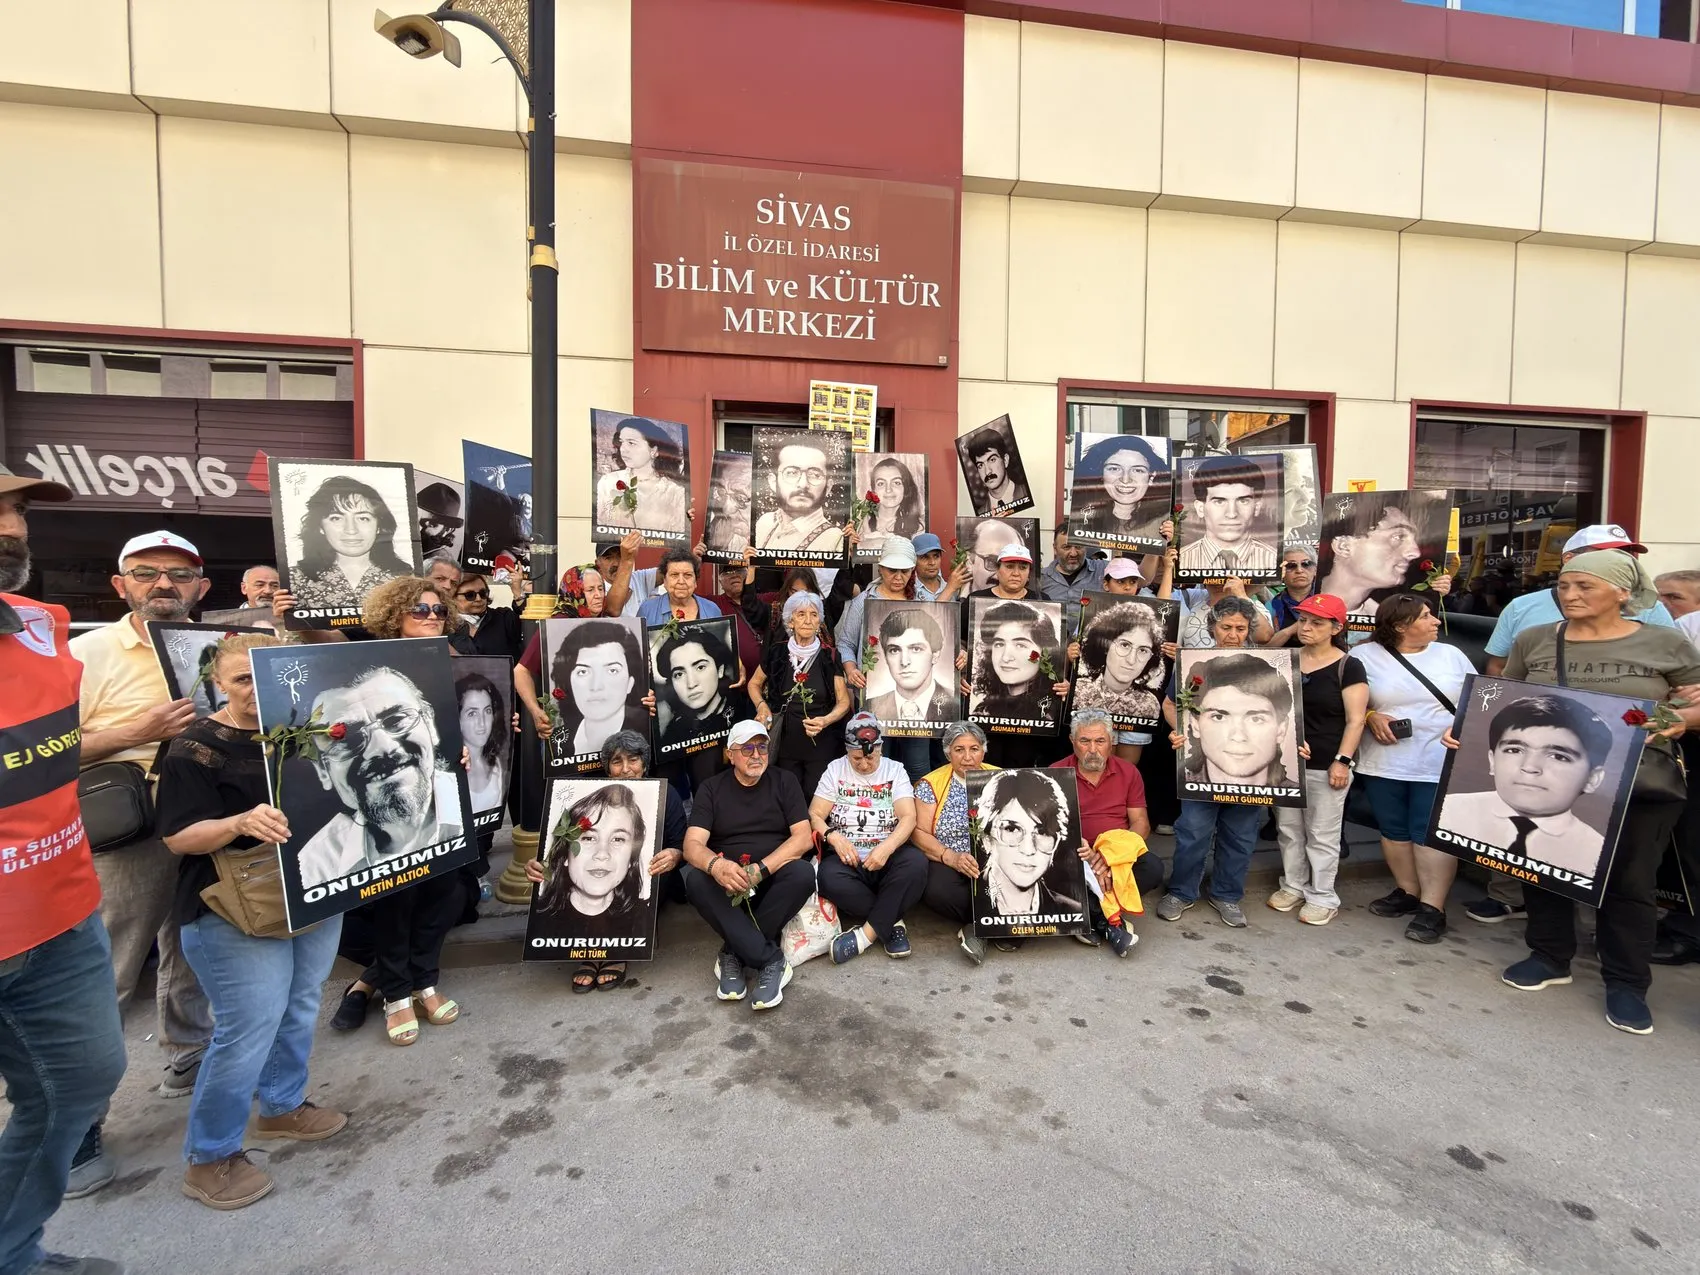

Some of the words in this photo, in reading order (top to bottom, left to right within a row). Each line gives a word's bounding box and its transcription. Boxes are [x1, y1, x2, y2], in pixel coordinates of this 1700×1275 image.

[756, 192, 851, 231] SİVAS
[724, 231, 742, 251] İL
[747, 234, 797, 257] ÖZEL
[803, 238, 880, 262] İDARESİ
[653, 257, 755, 295] BİLİM
[764, 278, 799, 298] ve
[807, 269, 941, 307] KÜLTÜR
[723, 307, 876, 340] MERKEZİ
[979, 496, 1030, 518] ONRUMUZ
[1074, 529, 1163, 547] ONURUMUZ
[707, 550, 744, 560] ONUR
[756, 549, 844, 560] ONURUMUZ
[775, 559, 796, 567] HASRET
[1178, 569, 1277, 577] ONURUMUZ
[293, 607, 363, 619] ONUR
[330, 617, 359, 626] HURİYE
[877, 719, 953, 729] NURUMUZ
[967, 715, 1055, 728] ONURUMUZ
[991, 725, 1016, 733] ASUMAN
[661, 729, 730, 753] ONURUMU
[550, 752, 602, 767] ONUR
[1185, 782, 1302, 797] ONURUMUZ
[1213, 794, 1239, 803] MURAT
[1240, 795, 1273, 805] GÜNDÜZ
[26, 821, 77, 853] SULTAN
[3, 844, 63, 874] ÜLTÜR
[1435, 829, 1593, 891] ONURUMUZ
[303, 836, 467, 904] ONURUMUZ
[1475, 854, 1510, 874] KORAY
[1511, 863, 1539, 884] KAYA
[359, 878, 394, 900] METİN
[396, 864, 431, 886] ALTIOK
[980, 913, 1084, 926] ONURUMUZ
[1011, 925, 1035, 935] ÖZLEM
[1035, 925, 1057, 935] ŞAHİN
[531, 937, 646, 948] ONURUMUZ
[570, 948, 587, 958] İNCİ
[588, 948, 607, 958] TÜRK
